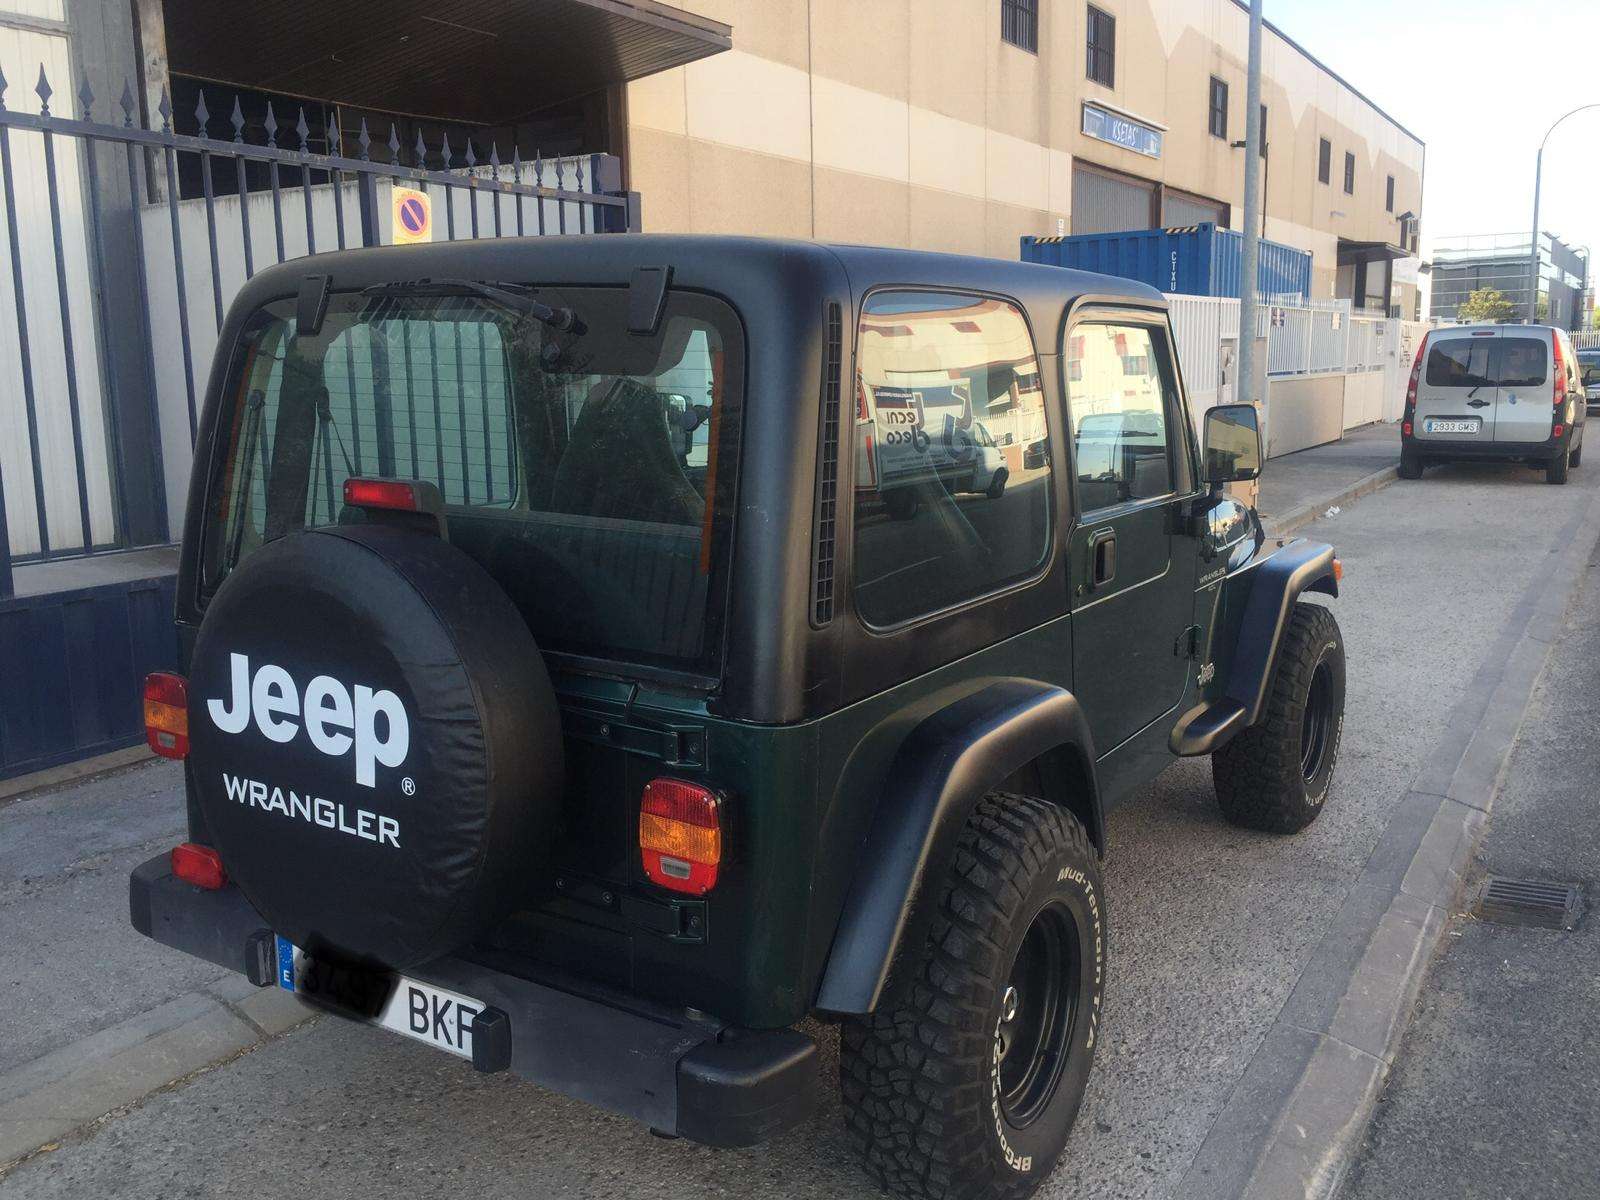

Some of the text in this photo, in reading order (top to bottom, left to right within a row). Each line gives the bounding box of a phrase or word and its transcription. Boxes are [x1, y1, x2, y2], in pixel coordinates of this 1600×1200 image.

[206, 652, 410, 789] Jeep
[222, 772, 401, 849] WRANGLER
[283, 969, 292, 983] E
[1056, 865, 1102, 1050] Mud-Terrain T/A
